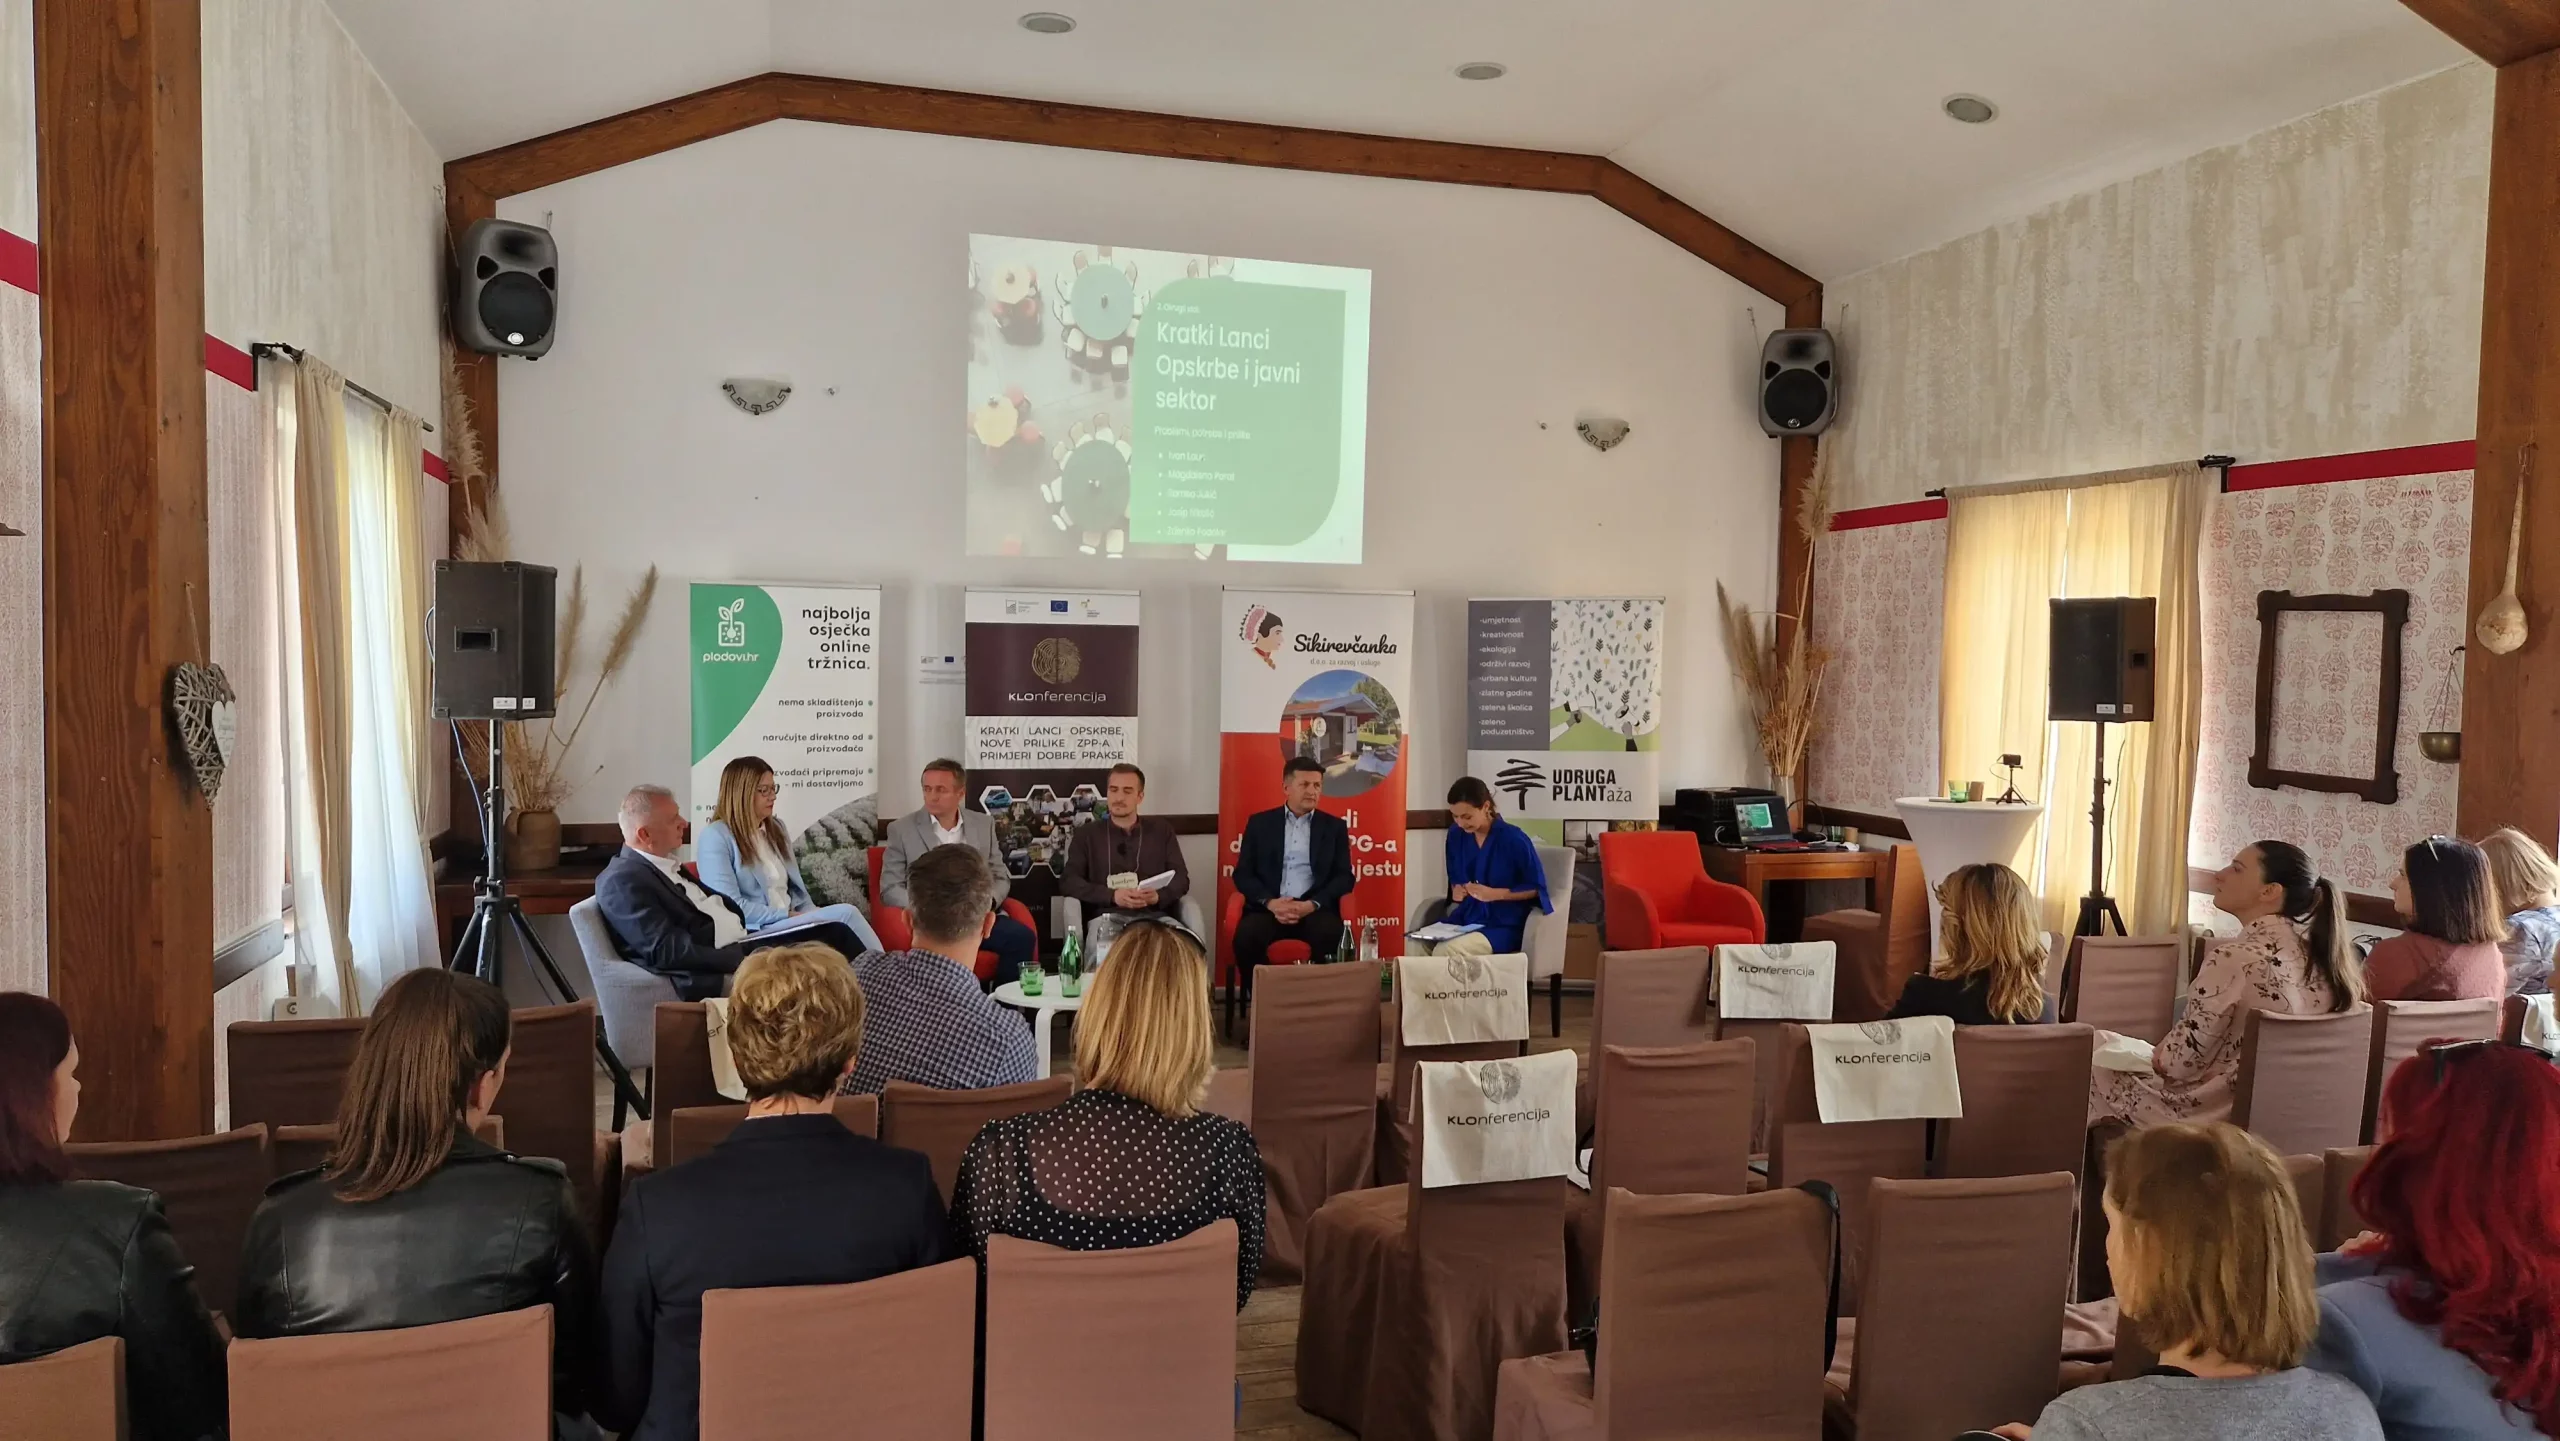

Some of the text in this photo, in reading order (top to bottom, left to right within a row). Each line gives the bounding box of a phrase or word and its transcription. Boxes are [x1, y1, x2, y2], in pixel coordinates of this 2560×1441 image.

[1157, 321, 1270, 350] Kratki Lanci
[1156, 354, 1300, 388] Opskrbe i javni
[1156, 387, 1217, 411] sektor
[802, 606, 870, 623] najbolja
[809, 622, 870, 639] osječka
[820, 640, 871, 653] online
[1293, 632, 1398, 655] Sikirevčanka
[703, 651, 759, 664] plodovi.hr
[807, 655, 870, 670] tržnica.
[1508, 660, 1531, 668] razvoj
[1008, 690, 1107, 704] KLOnferencija
[1506, 690, 1533, 698] godine
[778, 697, 864, 709] nema skladištenja
[816, 710, 864, 720] proizvoda
[810, 733, 850, 741] direktno
[852, 733, 864, 741] od
[980, 726, 1124, 737] KRATKI LANCI OPSKRBE,
[1480, 727, 1535, 737] poduzetništvo
[980, 738, 1124, 748] NOVE PRILIKE ZPP-A I
[980, 751, 1124, 761] PRIMJERI DOBRE PRAKSE
[812, 767, 864, 779] pripremaju
[1552, 769, 1616, 785] UDRUGA
[792, 779, 804, 788] mi
[806, 778, 864, 790] dostavljamo
[1552, 785, 1632, 802] PLANTaža
[1351, 858, 1402, 883] jestu
[1737, 965, 1815, 978] KLOnferencija
[1424, 987, 1508, 1000] KLOnferencija
[1834, 1049, 1932, 1064] KLOnferencija
[1447, 1107, 1551, 1126] KLOnferencija
